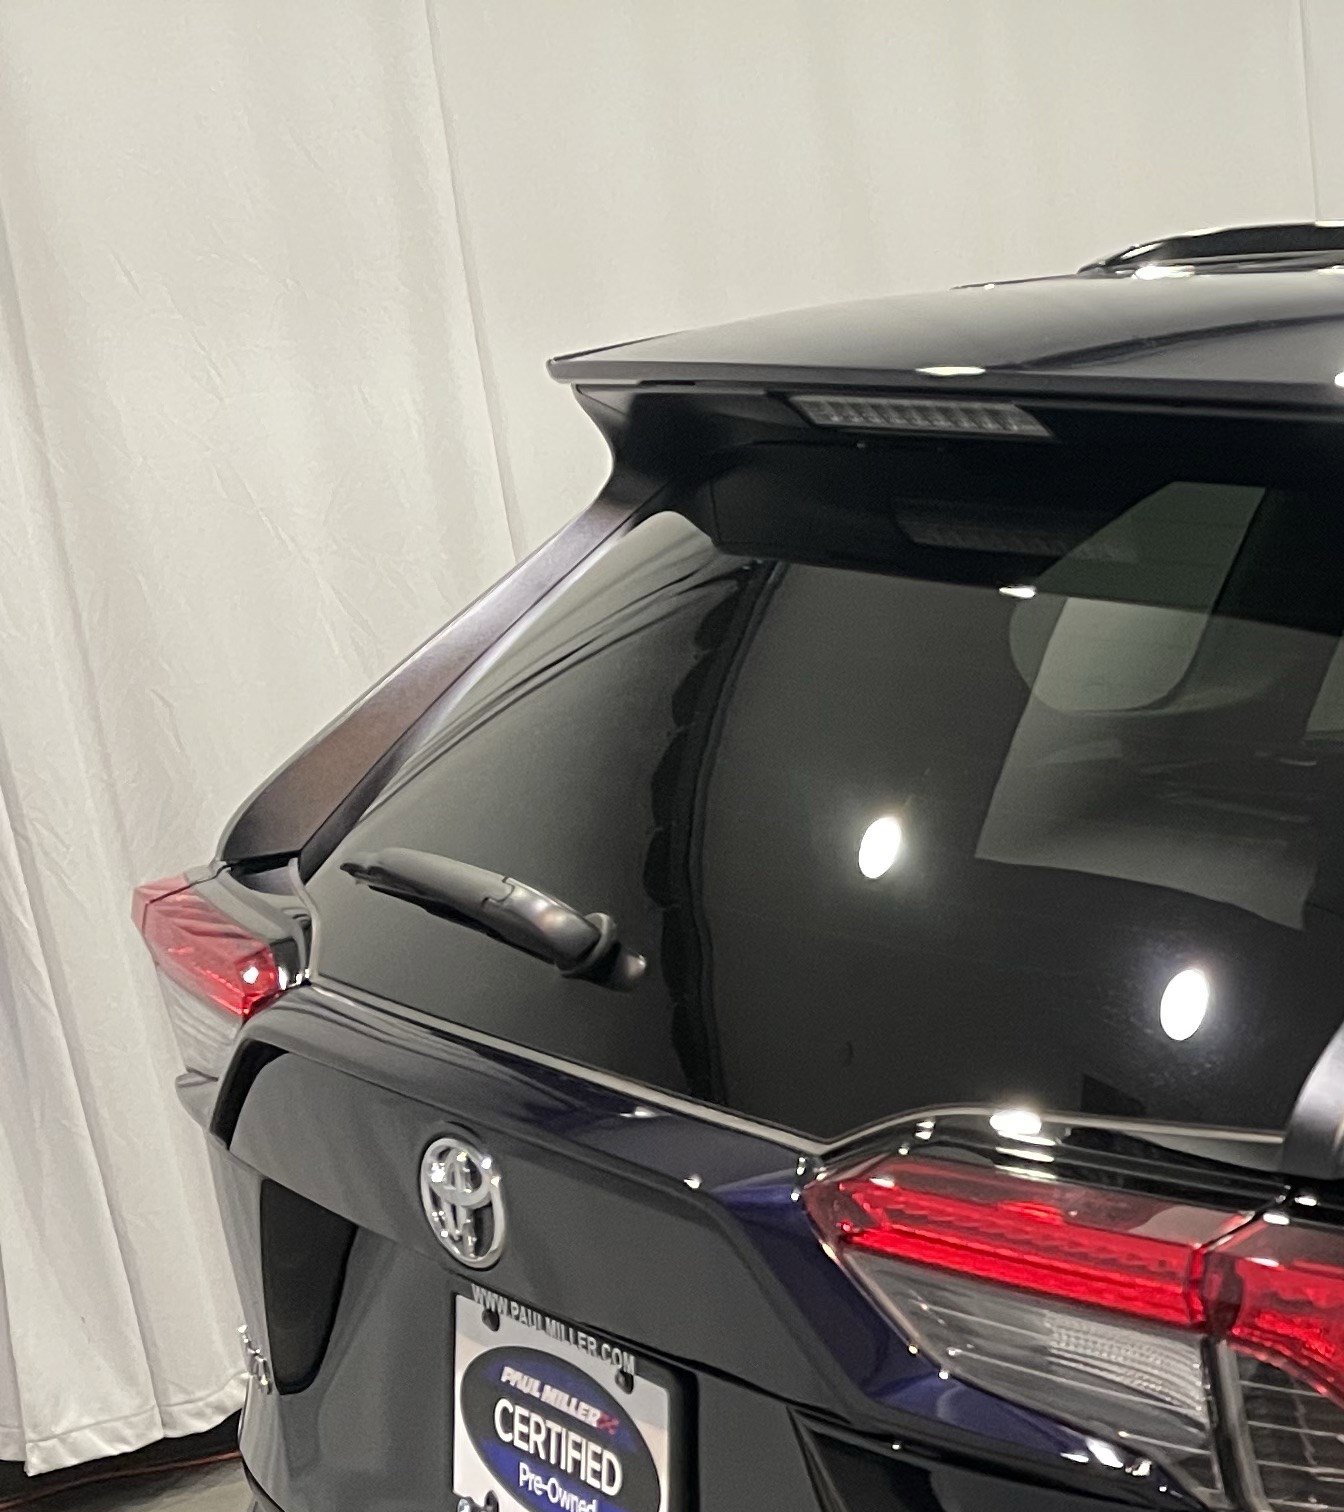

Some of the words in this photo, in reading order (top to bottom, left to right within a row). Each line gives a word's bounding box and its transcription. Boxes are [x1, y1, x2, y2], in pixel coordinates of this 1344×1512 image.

[501, 1366, 542, 1399] PAUL
[541, 1384, 601, 1428] MILLER
[494, 1398, 623, 1496] CERTIFIED
